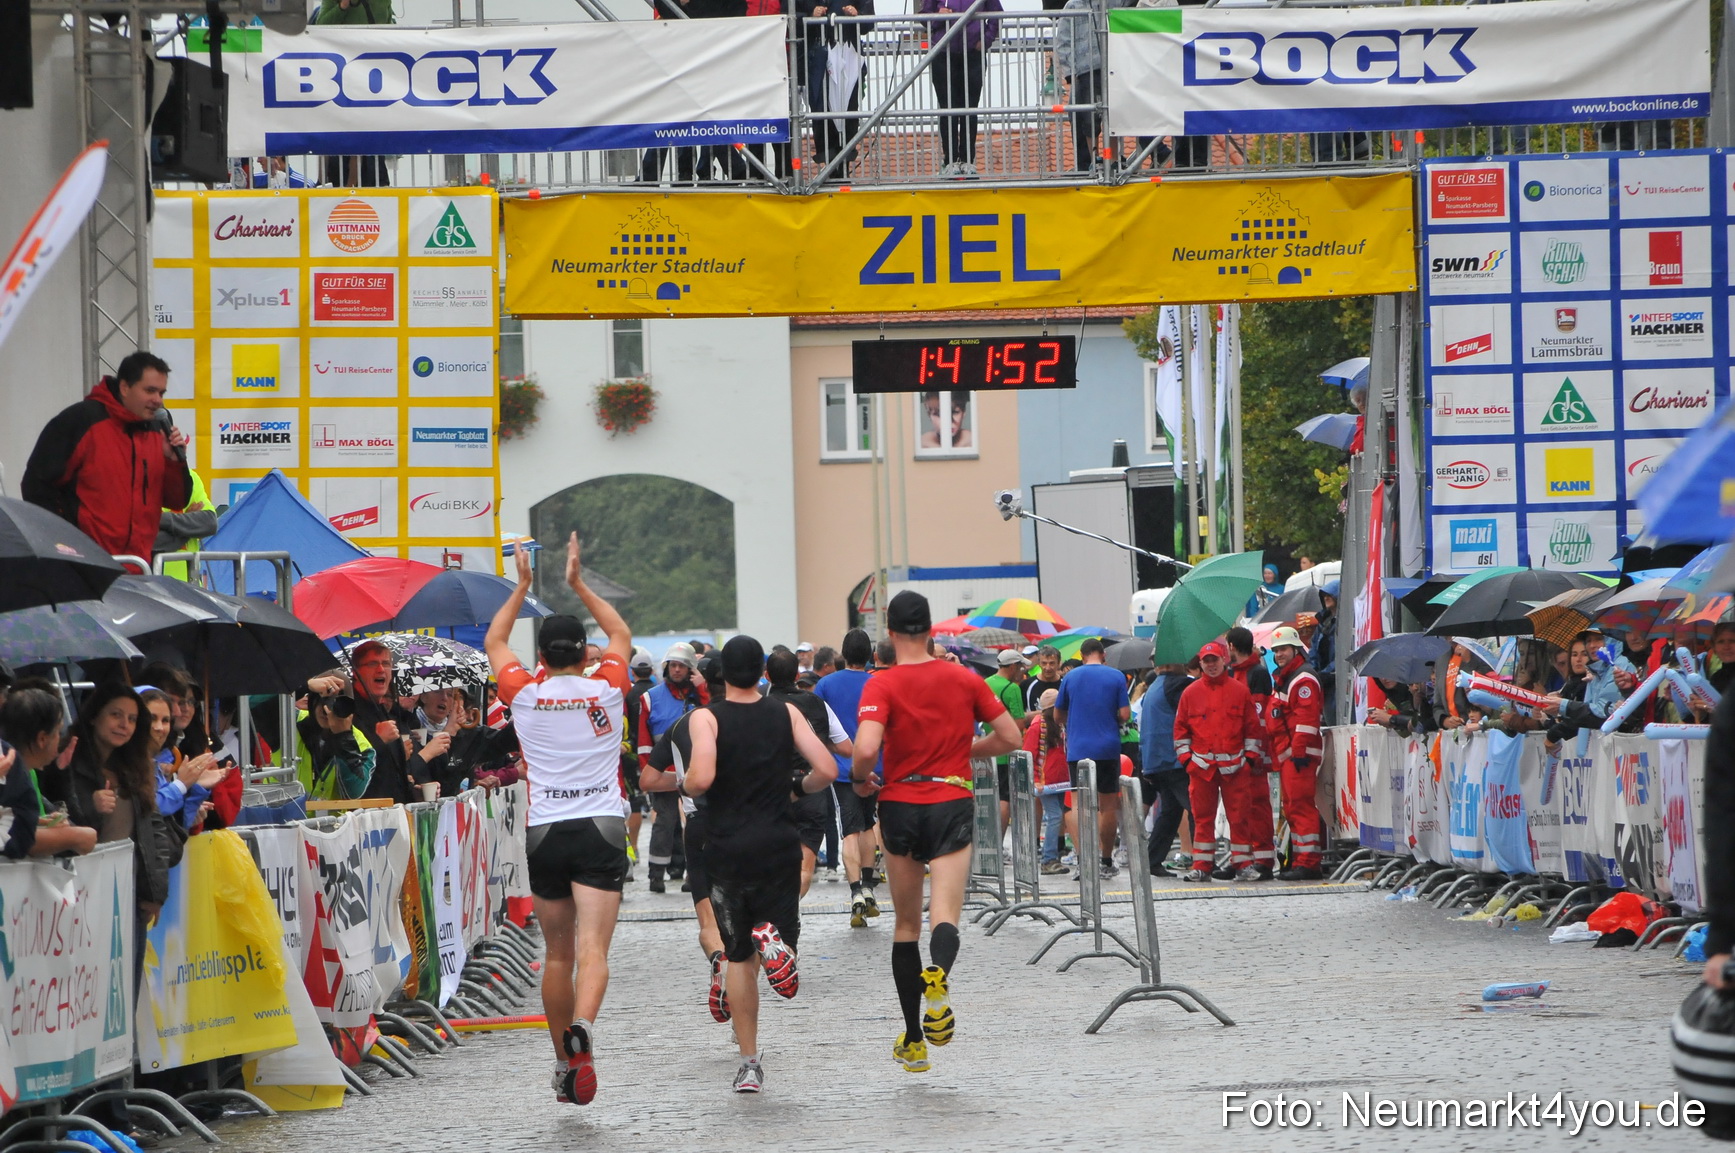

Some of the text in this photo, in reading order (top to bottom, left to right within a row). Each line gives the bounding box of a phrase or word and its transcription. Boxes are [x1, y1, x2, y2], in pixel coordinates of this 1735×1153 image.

[1183, 27, 1479, 87] BOCK
[263, 48, 557, 108] BOCK
[1572, 99, 1699, 115] www.bockonline.de
[654, 123, 778, 140] www.bockonline.de
[1437, 173, 1497, 185] GUT FÜR SIE!
[1549, 184, 1603, 197] Bionorica
[1659, 185, 1705, 194] ReiseCenter
[1445, 195, 1472, 203] Sparkasse
[1445, 202, 1498, 210] Neumarkt-Parsberg
[214, 214, 295, 241] Charivari
[327, 224, 381, 233] WITTMANN
[332, 238, 374, 252] VERPACKUNG
[859, 214, 1061, 285] ZIEL
[1172, 238, 1366, 263] Neumarkter Stadtlauf
[550, 257, 746, 275] Neumarkter Stadtlauf
[1432, 256, 1480, 273] swn
[1649, 261, 1680, 275] Braun
[1431, 271, 1495, 280] stadtwerke neumarkt
[1543, 261, 1589, 284] SCHAU
[321, 276, 387, 288] GUT FÜR SIE!
[331, 298, 361, 306] Sparkasse
[331, 305, 387, 314] Neumarkt-Parsberg
[1641, 311, 1704, 323] INTERSPORT
[1631, 322, 1704, 336] HACKNER
[1540, 336, 1594, 346] Neumarkter
[1456, 341, 1479, 355] DEHN
[1531, 345, 1603, 358] Lammsbräu
[333, 366, 393, 374] TUI ReiseCenter
[438, 362, 487, 372] Bionorica
[236, 376, 275, 388] KANN
[1629, 386, 1710, 413] Charivari
[1455, 404, 1511, 415] MAX BÖGL
[230, 421, 291, 432] INTERSPORT
[220, 433, 291, 445] HACKNER
[338, 437, 394, 447] MAX BÖGL
[415, 431, 485, 441] Neumarkter Tagblatt
[1435, 467, 1478, 476] GERHART
[1453, 474, 1485, 483] JANIG
[1550, 480, 1590, 492] KANN
[342, 514, 365, 527] DEHN
[1455, 523, 1493, 545] maxi
[1551, 542, 1595, 564] SCHAU
[1478, 553, 1493, 566] dsl
[544, 789, 580, 799] TEAM
